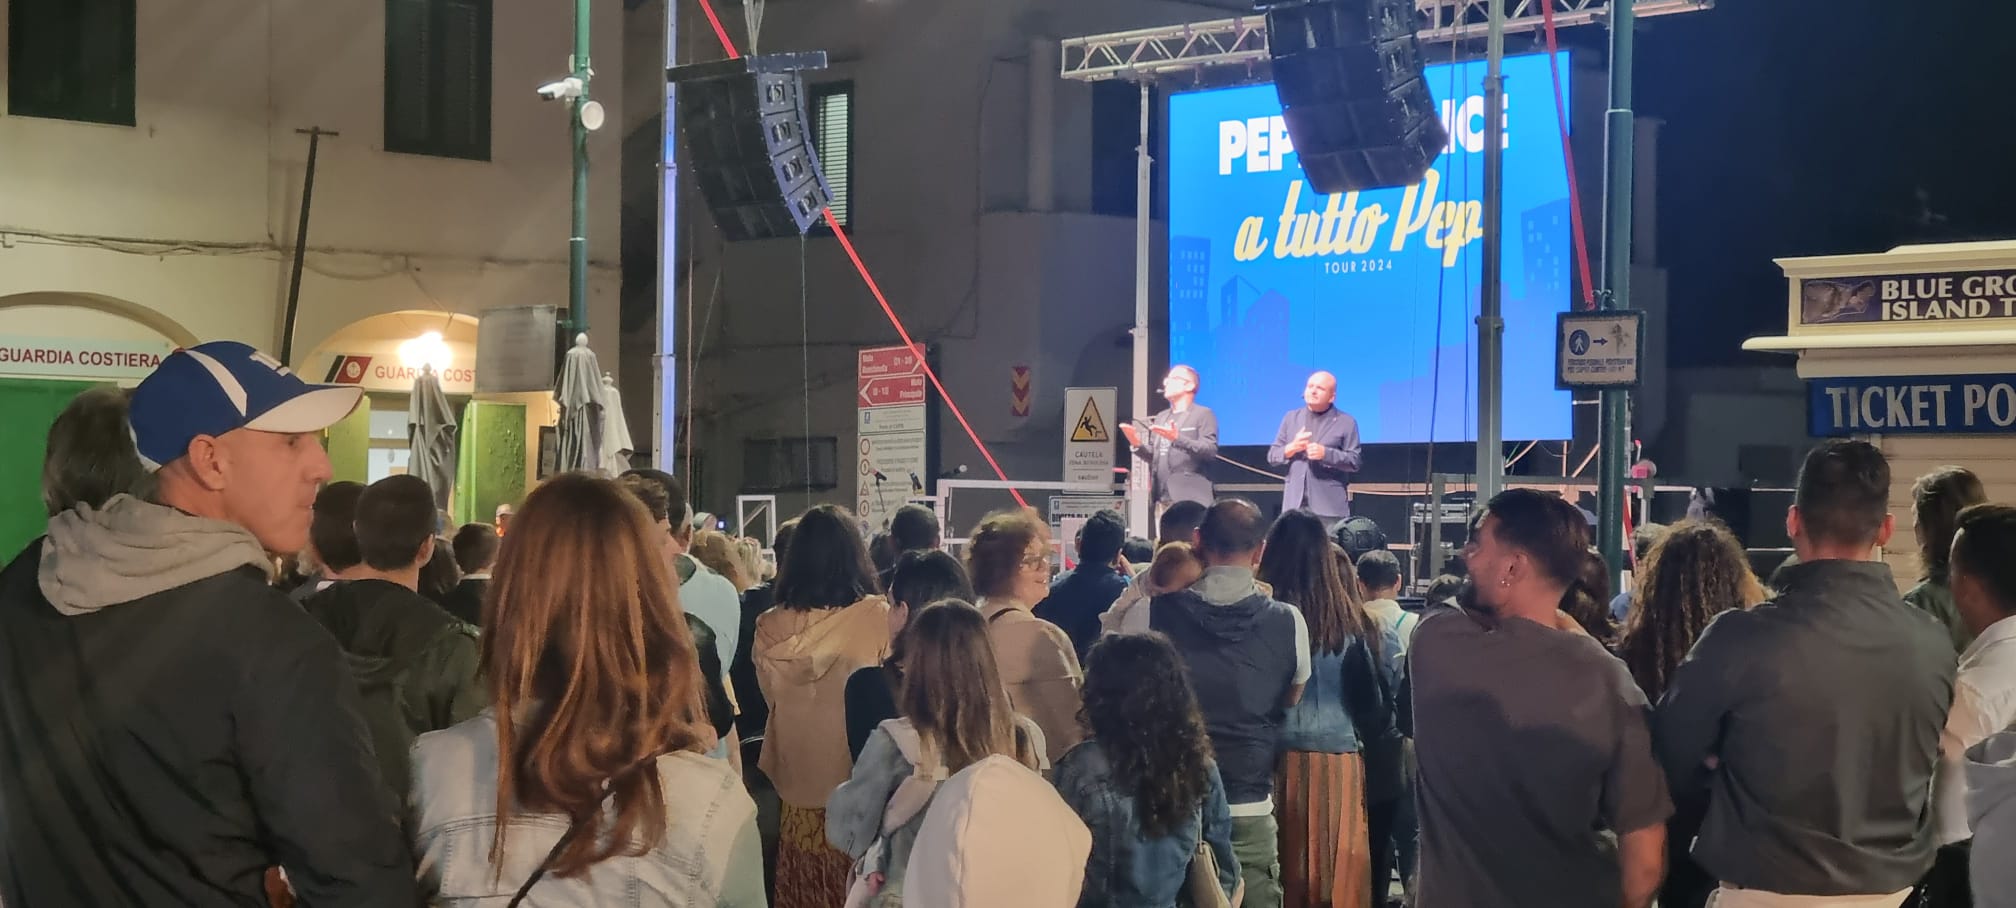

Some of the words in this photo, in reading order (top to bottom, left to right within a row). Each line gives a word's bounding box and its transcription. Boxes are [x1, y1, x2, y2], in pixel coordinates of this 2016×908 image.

[1218, 115, 1302, 175] PEP
[1233, 215, 1268, 262] a
[1273, 180, 1388, 259] tutto
[1324, 260, 1356, 274] TOUR
[1361, 258, 1392, 272] 2024
[1881, 278, 1953, 300] BLUE
[1881, 297, 1991, 321] ISLAND
[0, 347, 74, 365] GUARDIA
[78, 350, 161, 368] COSTIERA
[1825, 384, 1953, 428] TICKET
[1962, 382, 2016, 427] PO
